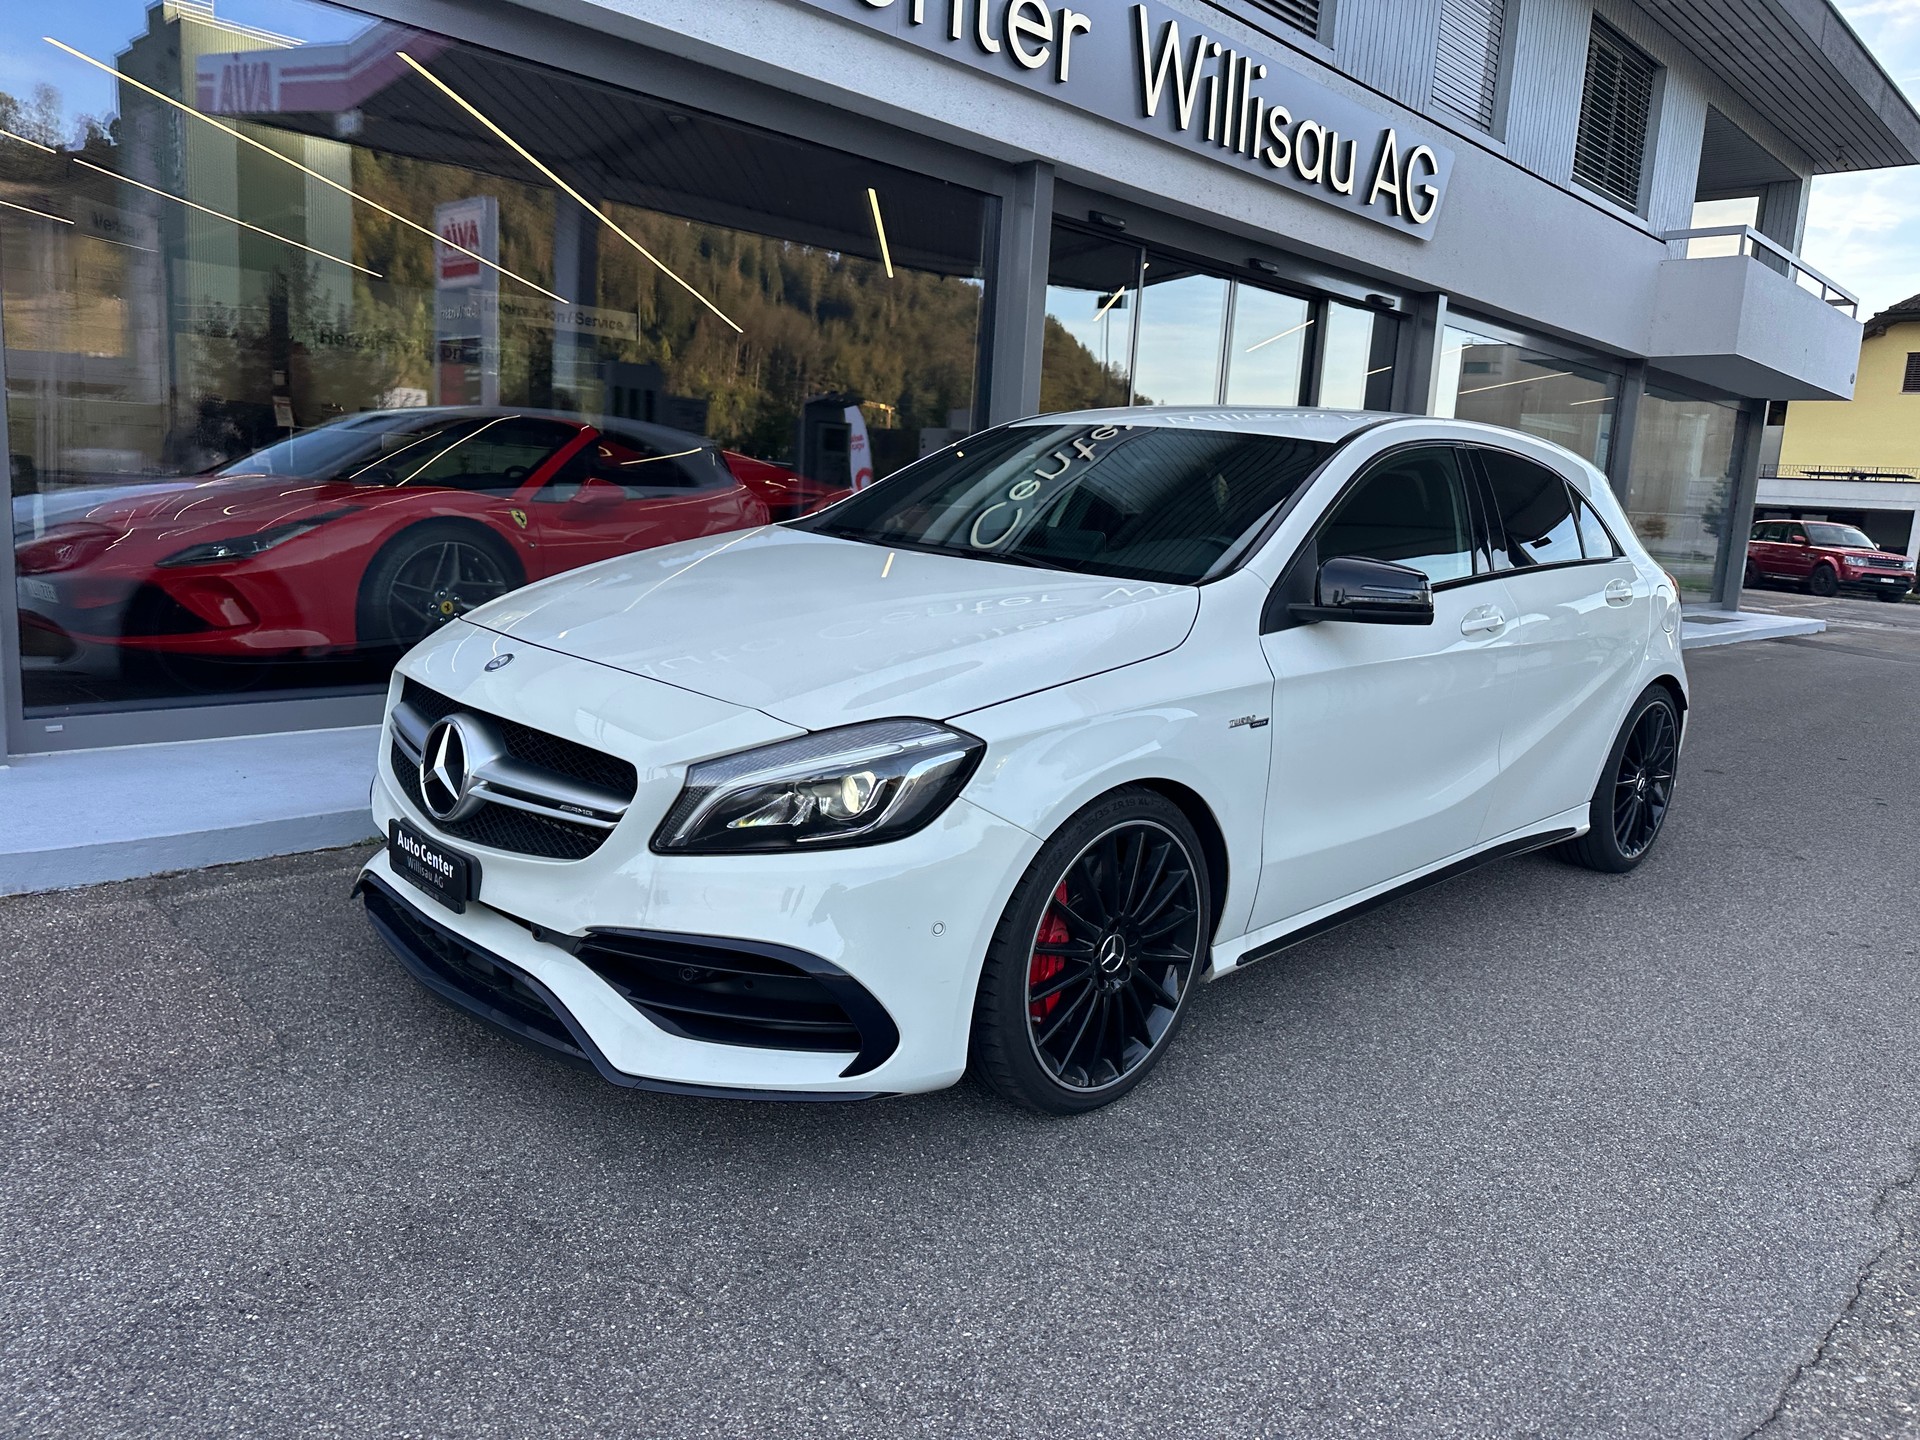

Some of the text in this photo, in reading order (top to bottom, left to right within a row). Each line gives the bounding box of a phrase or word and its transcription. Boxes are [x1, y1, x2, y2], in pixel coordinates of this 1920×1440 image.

[1134, 4, 1357, 195] Willisau
[1367, 128, 1439, 224] AG
[407, 855, 433, 882] Willisau
[434, 873, 444, 889] AG
